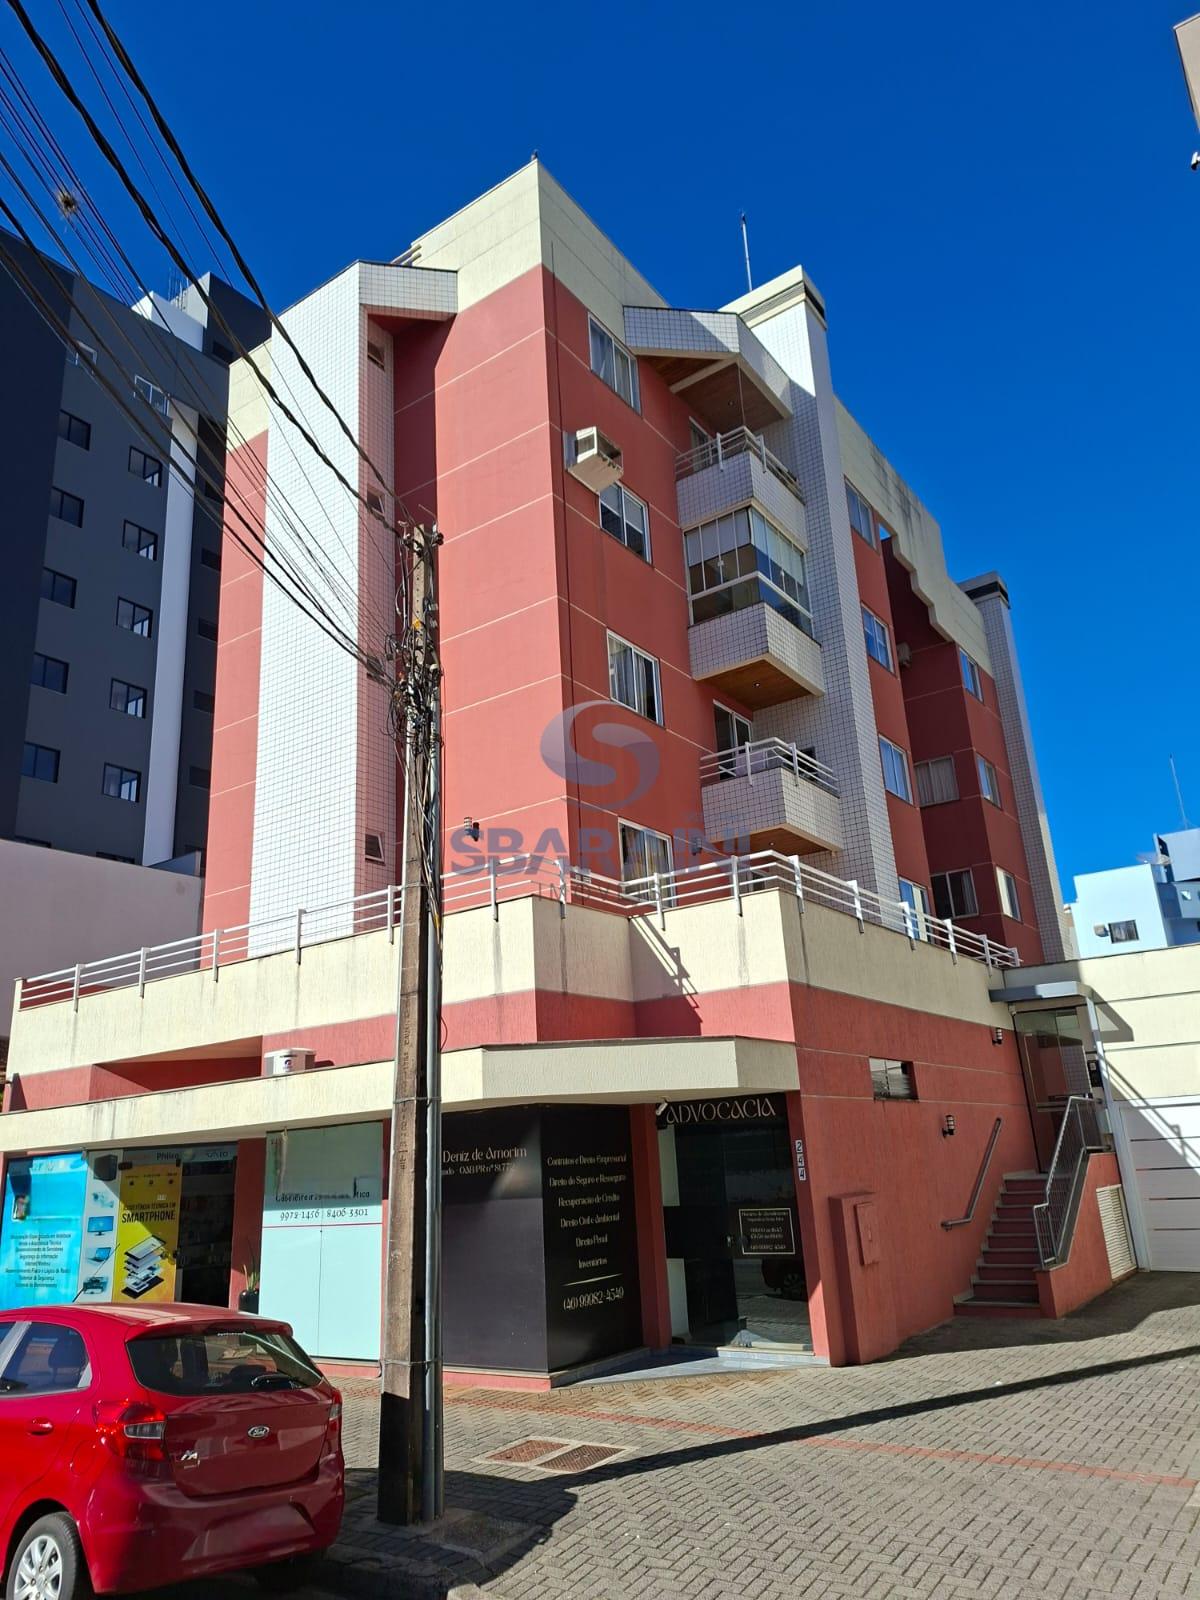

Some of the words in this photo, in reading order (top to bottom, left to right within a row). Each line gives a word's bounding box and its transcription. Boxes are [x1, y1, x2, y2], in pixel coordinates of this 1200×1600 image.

[666, 1097, 776, 1124] ADVOCACIA
[471, 1147, 483, 1161] de
[485, 1146, 527, 1160] Amorim
[549, 1176, 568, 1187] Direito
[576, 1175, 595, 1187] Seguro
[122, 1209, 176, 1223] SMARTPHONE
[560, 1216, 578, 1229] Direito
[575, 1236, 593, 1248] Direito
